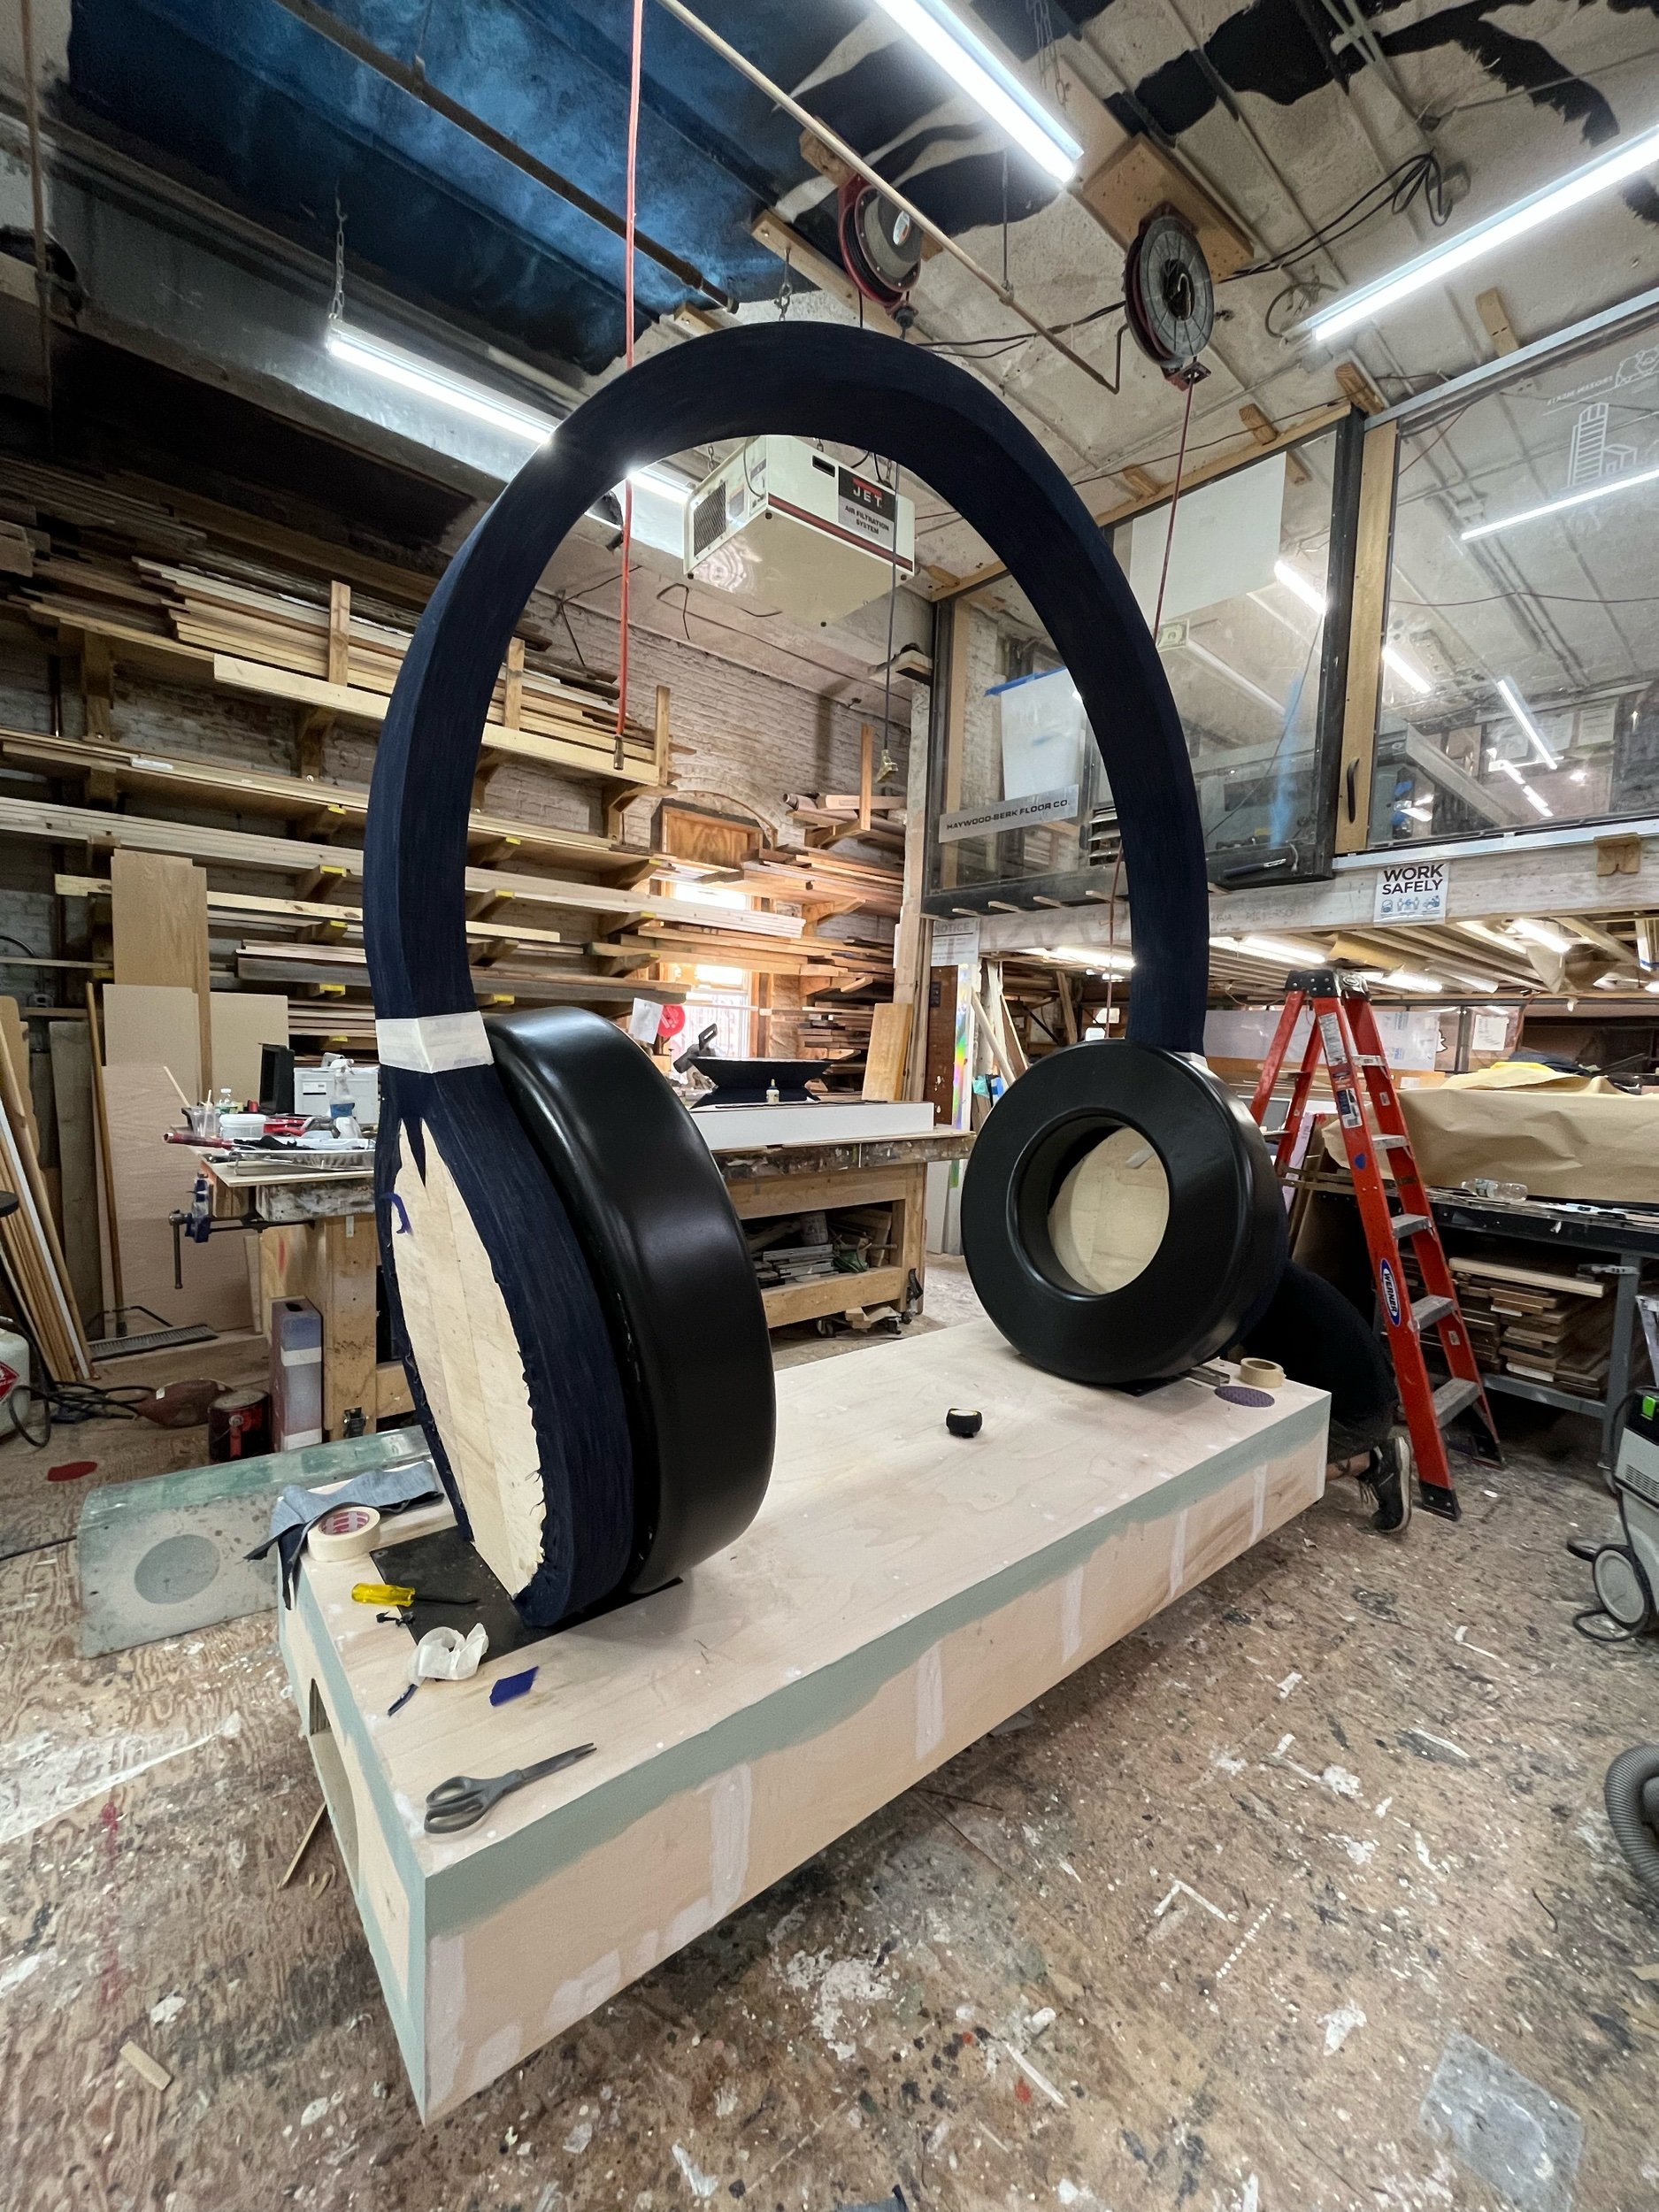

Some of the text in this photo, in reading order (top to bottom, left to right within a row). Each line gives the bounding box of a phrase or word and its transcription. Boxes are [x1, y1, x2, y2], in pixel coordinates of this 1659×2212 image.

[853, 485, 883, 509] JET
[845, 504, 889, 532] AIR FILTRATION
[856, 518, 879, 535] SYSTEM
[947, 809, 1018, 830] HAYWOOD-BERK
[1019, 803, 1051, 816] FLOOR
[1383, 864, 1444, 882] WORK
[1382, 879, 1443, 895] SAFELY
[1384, 1273, 1398, 1312] WERNER
